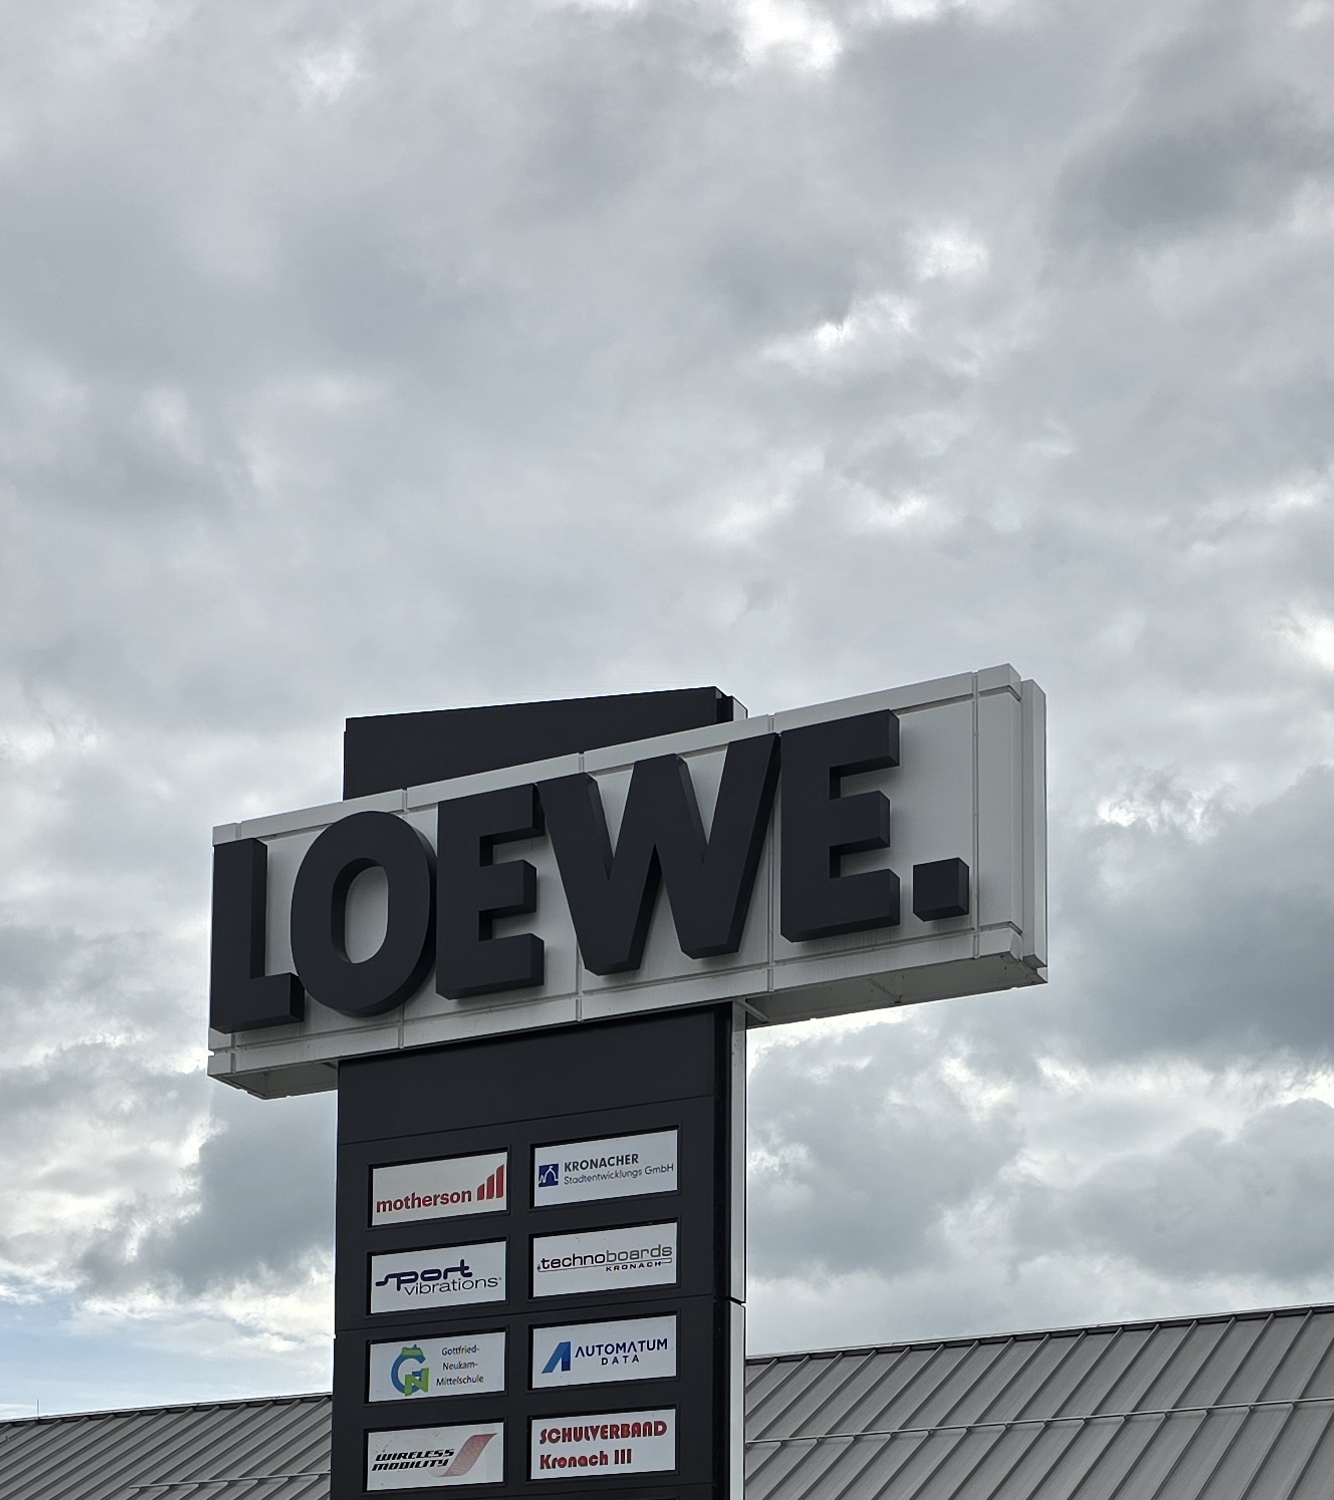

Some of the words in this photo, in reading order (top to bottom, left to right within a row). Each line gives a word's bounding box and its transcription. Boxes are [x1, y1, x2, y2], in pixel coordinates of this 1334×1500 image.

[210, 709, 970, 1035] LOEWE.
[564, 1153, 639, 1173] KRONACHER
[563, 1168, 643, 1186] Stadtentwicklungs
[644, 1163, 674, 1175] GmbH
[376, 1191, 472, 1213] motherson
[540, 1244, 673, 1270] technoboards
[605, 1260, 663, 1272] KRONACH
[375, 1258, 473, 1291] sport
[403, 1277, 499, 1296] vibrations
[441, 1344, 480, 1356] Gottfried-
[574, 1338, 668, 1359] AUTOMATUM
[442, 1361, 478, 1371] Neukam-
[601, 1354, 640, 1366] DATA
[436, 1374, 484, 1387] Mittelschule
[539, 1420, 668, 1445] SCHULVERBAND
[374, 1448, 455, 1462] WIRELESS
[540, 1450, 609, 1470] Kronach
[614, 1448, 632, 1465] III
[371, 1459, 450, 1472] MOBILITY
